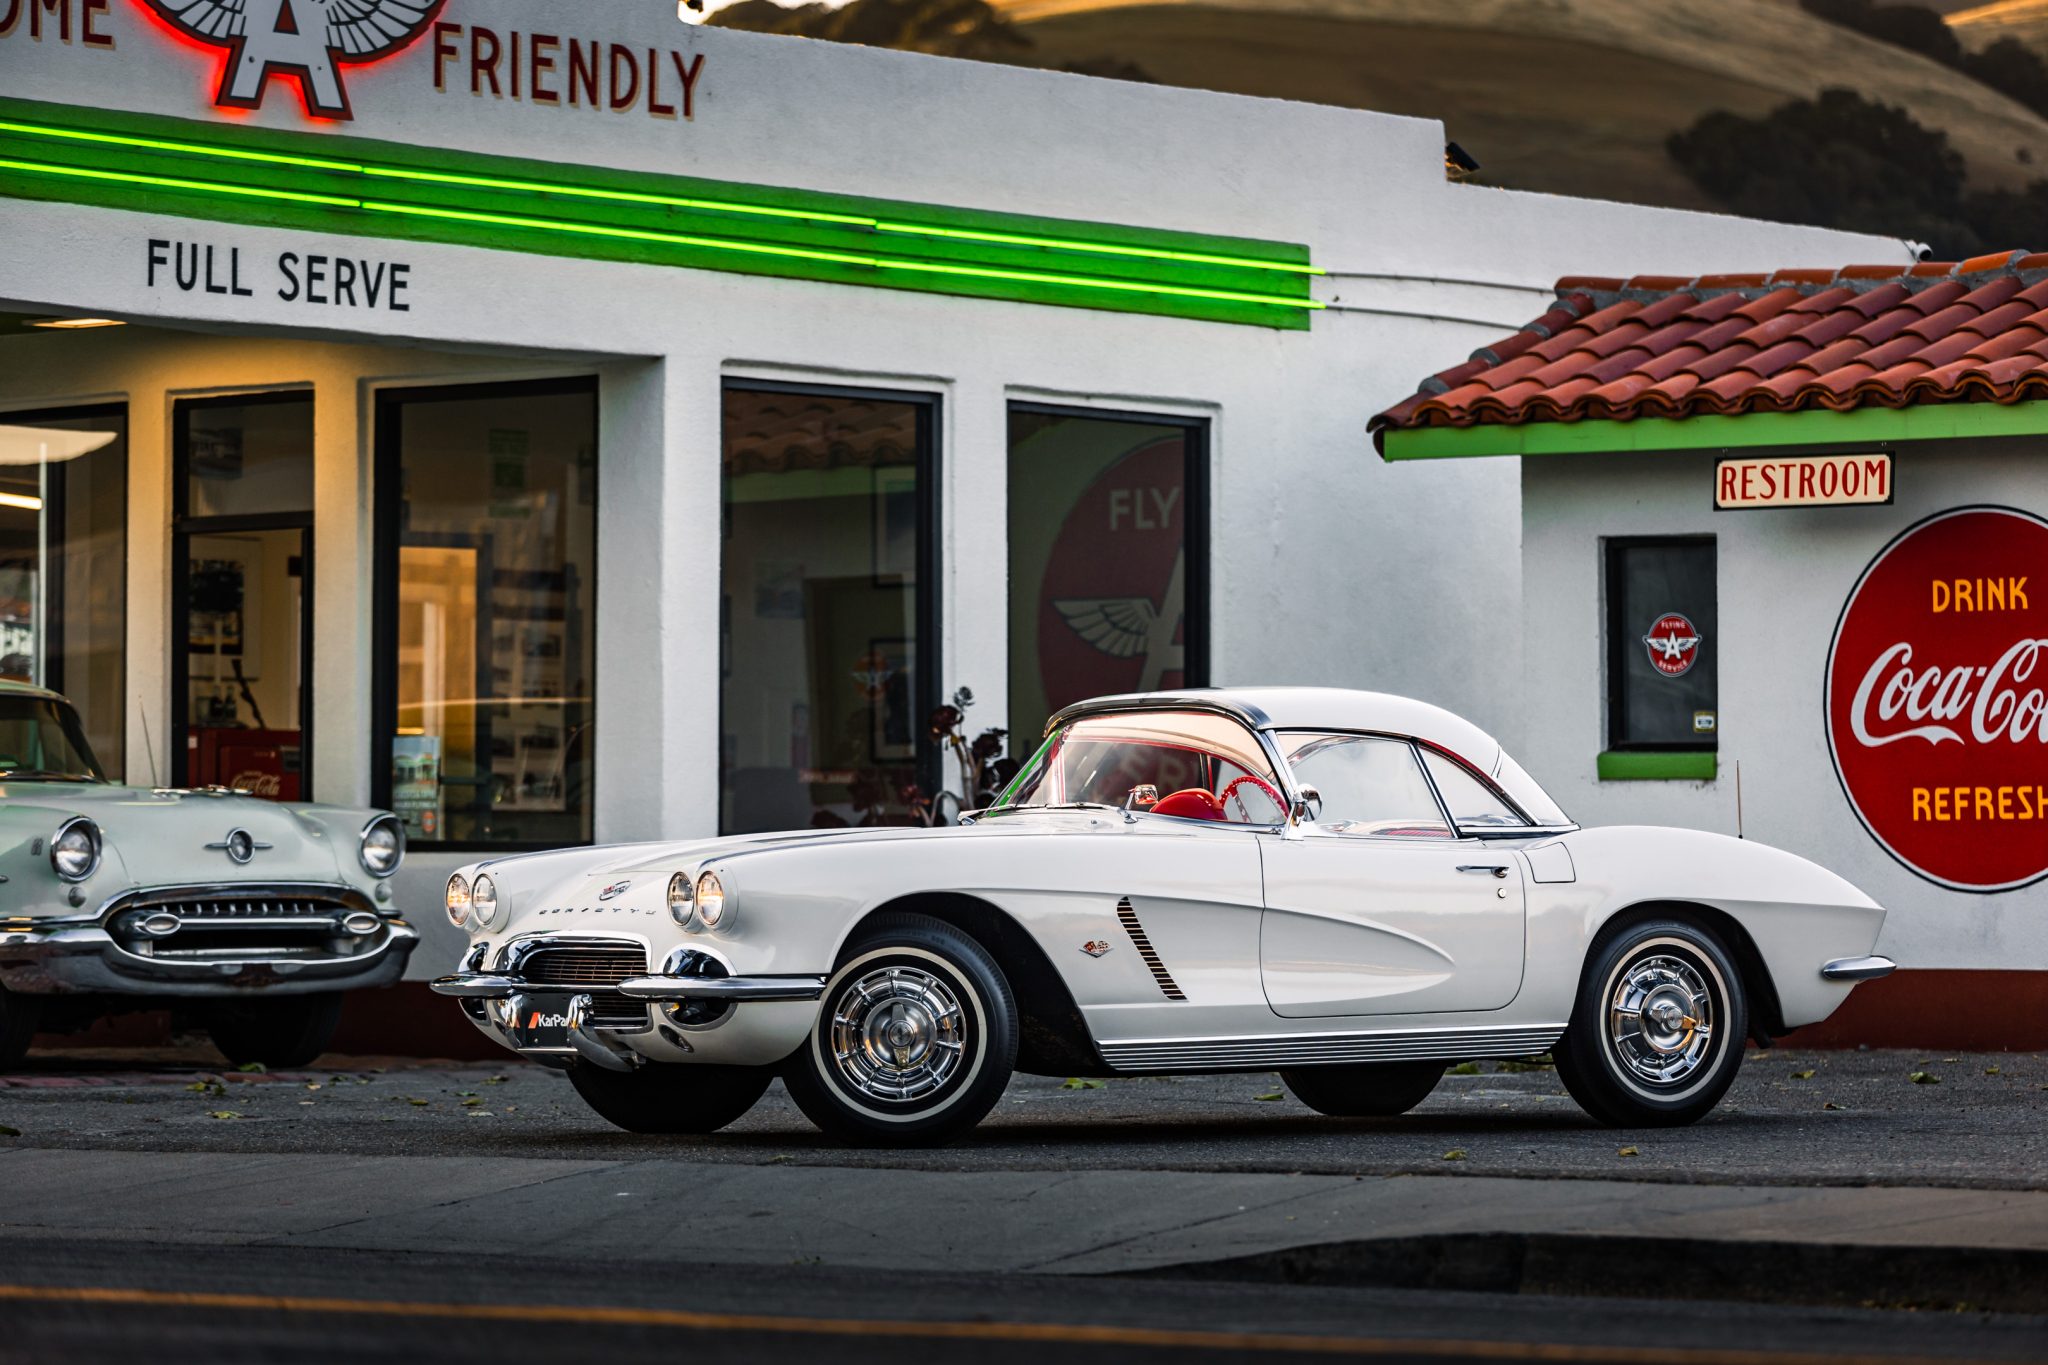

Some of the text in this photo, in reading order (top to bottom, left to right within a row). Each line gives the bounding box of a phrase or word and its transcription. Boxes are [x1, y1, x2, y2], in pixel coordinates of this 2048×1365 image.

[0, 0, 116, 50] ME
[433, 21, 706, 121] FRIENDLY
[148, 238, 411, 311] FULL SERVE
[1721, 459, 1886, 501] RESTROOM
[1932, 576, 2029, 613] DRINK
[1661, 620, 1686, 630] FLYING
[1664, 631, 1682, 660] A
[1658, 659, 1688, 673] SERVICE
[1850, 638, 2048, 748] Coca-Co
